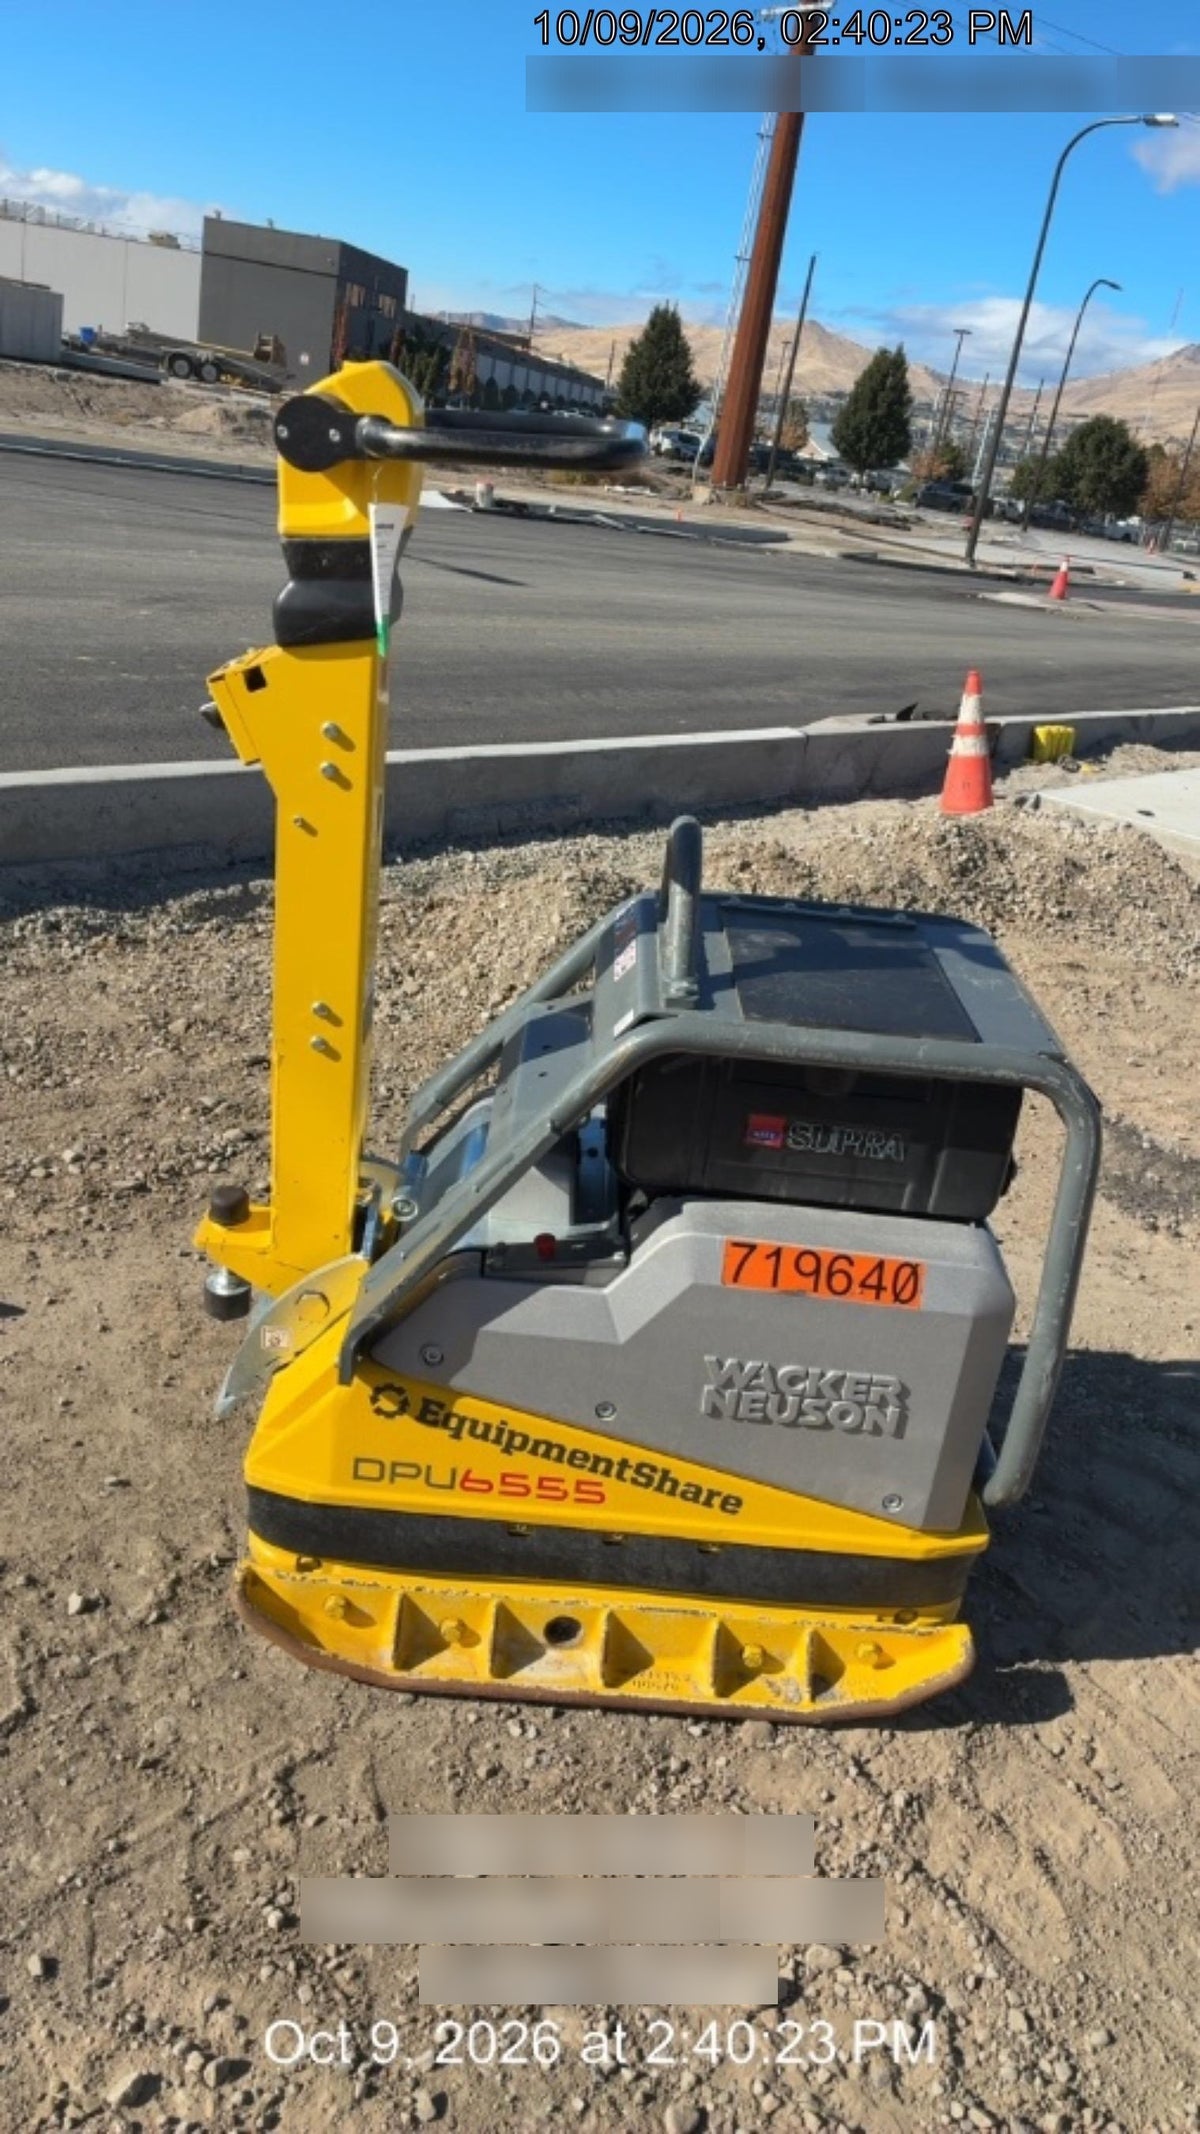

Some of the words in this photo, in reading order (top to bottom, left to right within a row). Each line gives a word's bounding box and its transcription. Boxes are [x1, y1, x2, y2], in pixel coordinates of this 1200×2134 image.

[786, 1121, 905, 1162] SUPRA
[729, 1242, 921, 1305] 719640
[702, 1355, 910, 1407] WACKER
[701, 1384, 909, 1438] NEUSON
[352, 1457, 606, 1504] DPU6555
[418, 1397, 743, 1515] EquipmentShare
